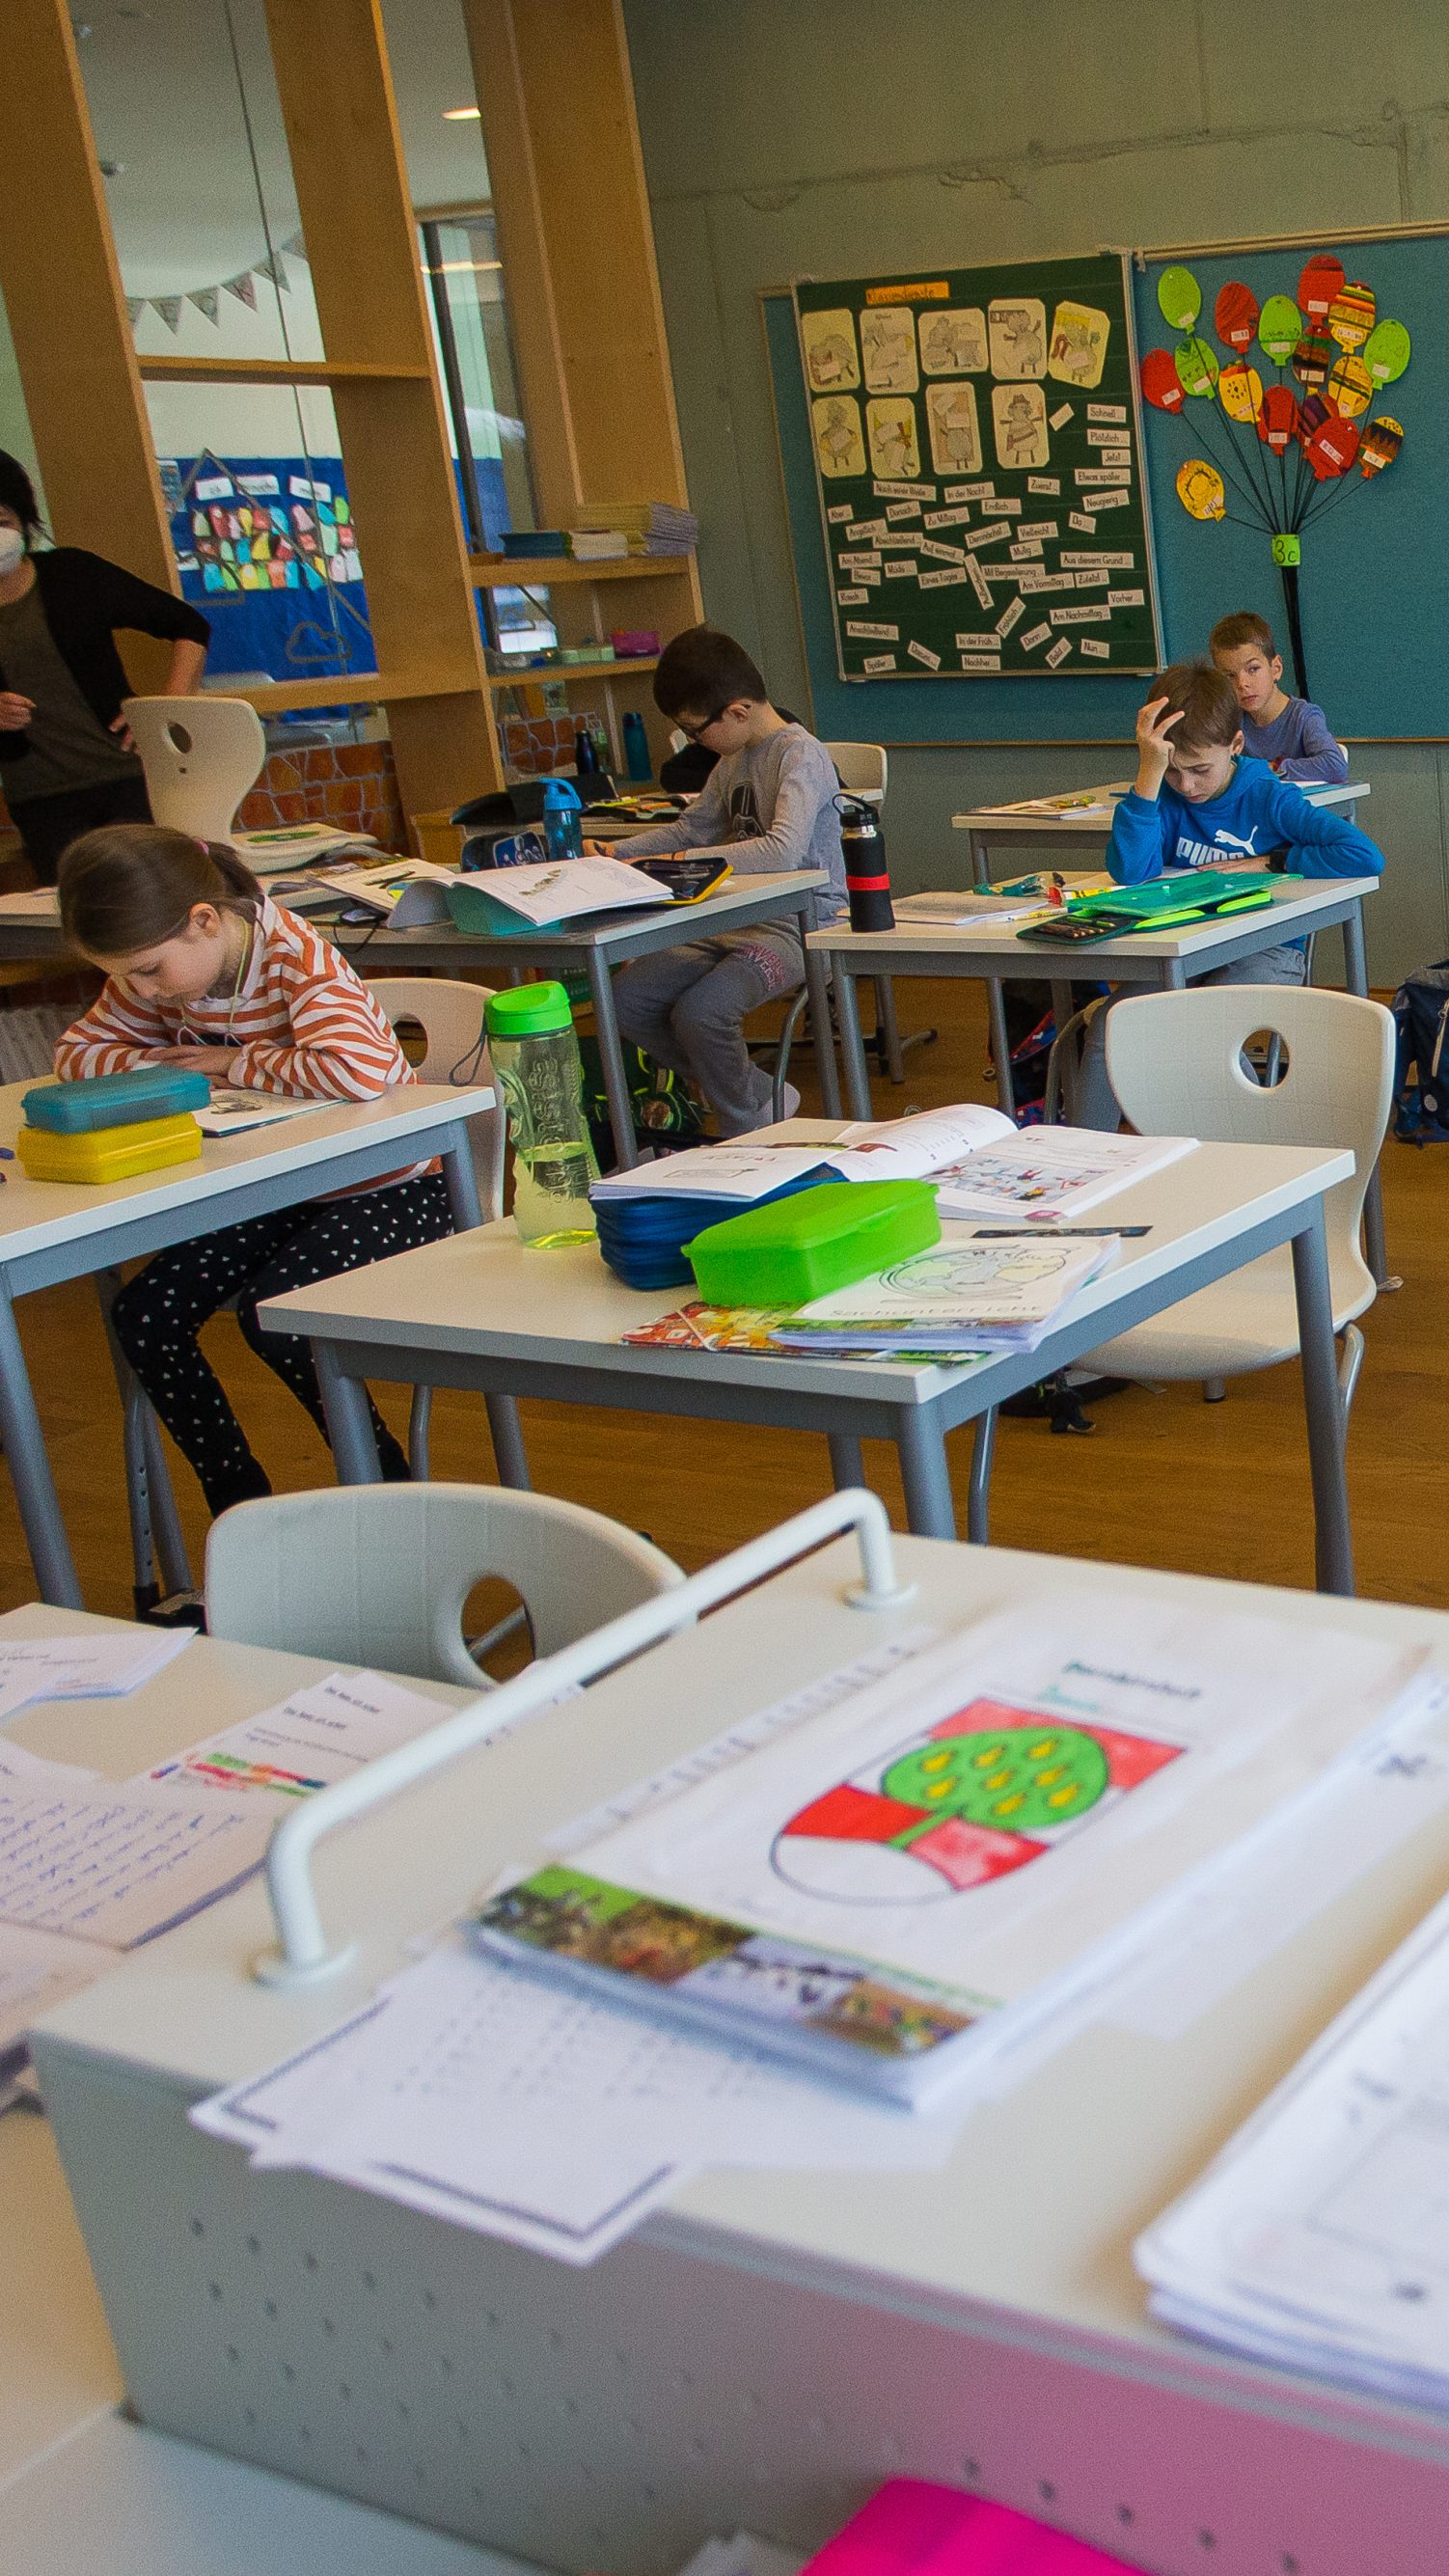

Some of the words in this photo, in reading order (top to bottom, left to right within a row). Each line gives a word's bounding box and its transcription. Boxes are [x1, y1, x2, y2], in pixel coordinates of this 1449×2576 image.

[1089, 407, 1116, 418] Schnell
[1078, 472, 1098, 481] Etwas
[965, 486, 985, 496] Nacht
[1030, 481, 1053, 490] Zuerst
[985, 503, 1008, 511] Endlich
[1086, 495, 1118, 508] Neugierig
[1020, 526, 1049, 537] Vielleicht
[1013, 545, 1032, 557] Mutig
[1275, 539, 1297, 563] 3c
[1064, 555, 1078, 564] Aus
[1079, 555, 1100, 564] diesem
[1103, 556, 1123, 565] Grund
[1035, 578, 1064, 589] Vormittag
[1110, 594, 1133, 604] Vorher
[1066, 609, 1102, 620] Nachmittag
[1083, 642, 1098, 652] Nun
[1048, 648, 1064, 664] Bald
